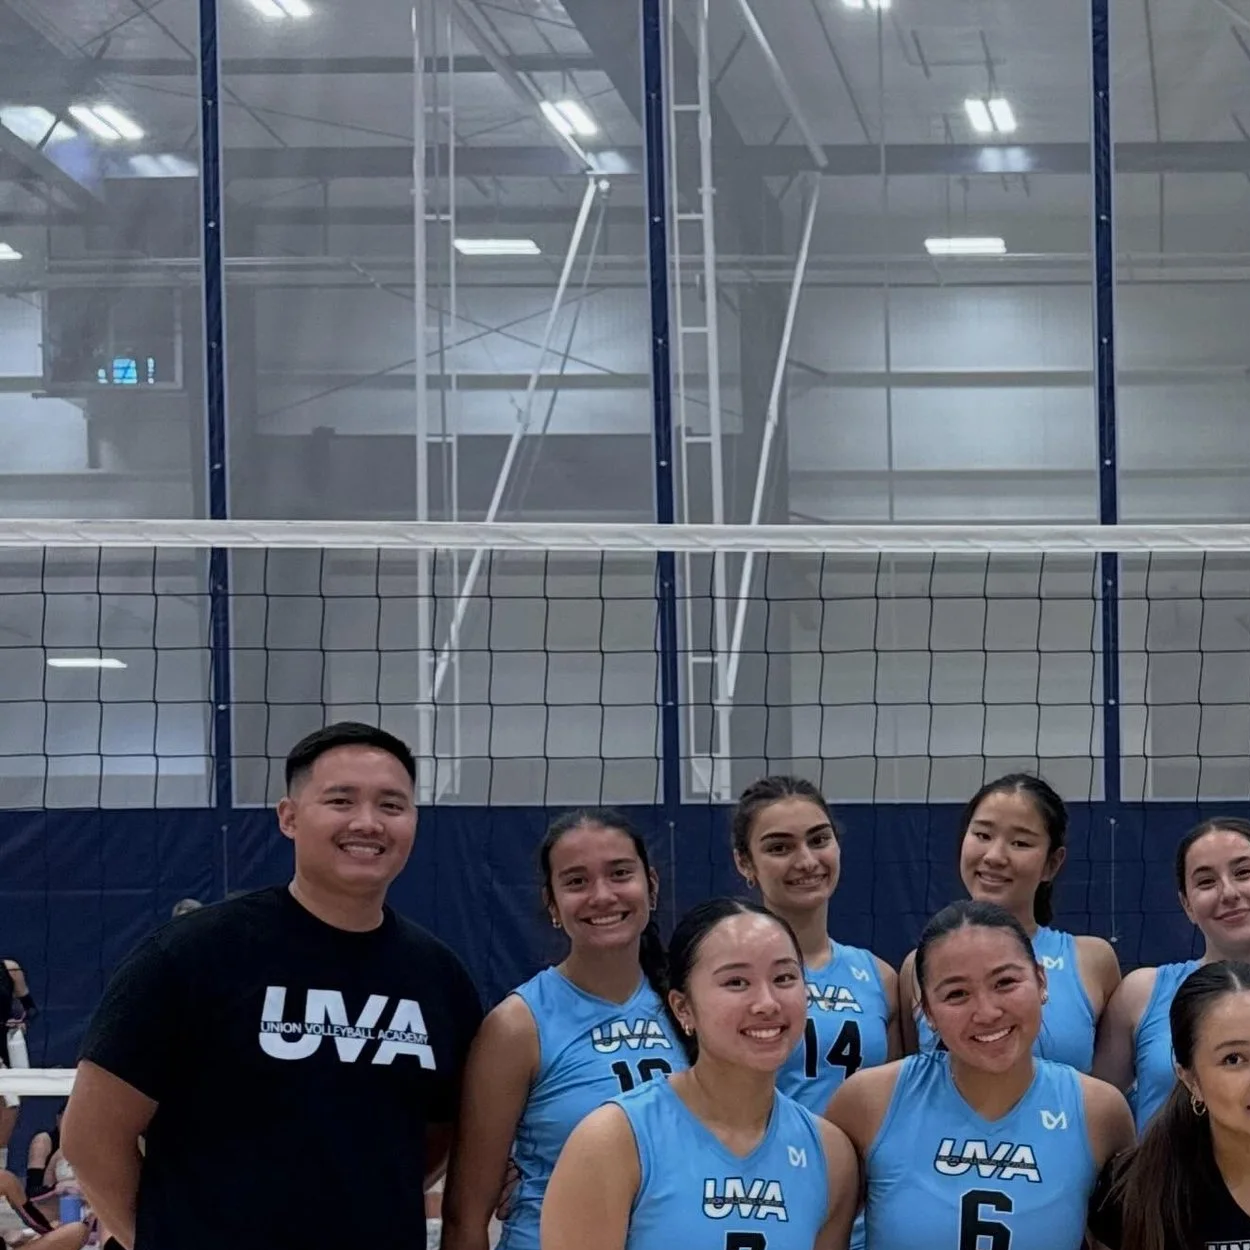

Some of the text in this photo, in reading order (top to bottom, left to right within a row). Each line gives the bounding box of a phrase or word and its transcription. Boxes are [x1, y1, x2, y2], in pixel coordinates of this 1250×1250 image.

[258, 985, 437, 1071] UVA
[260, 1021, 429, 1044] UNION VOLLEYBALL ACADEMY
[591, 1017, 673, 1054] UVA
[803, 1016, 863, 1080] 14
[933, 1137, 1043, 1183] UVA
[702, 1176, 790, 1222] UVA
